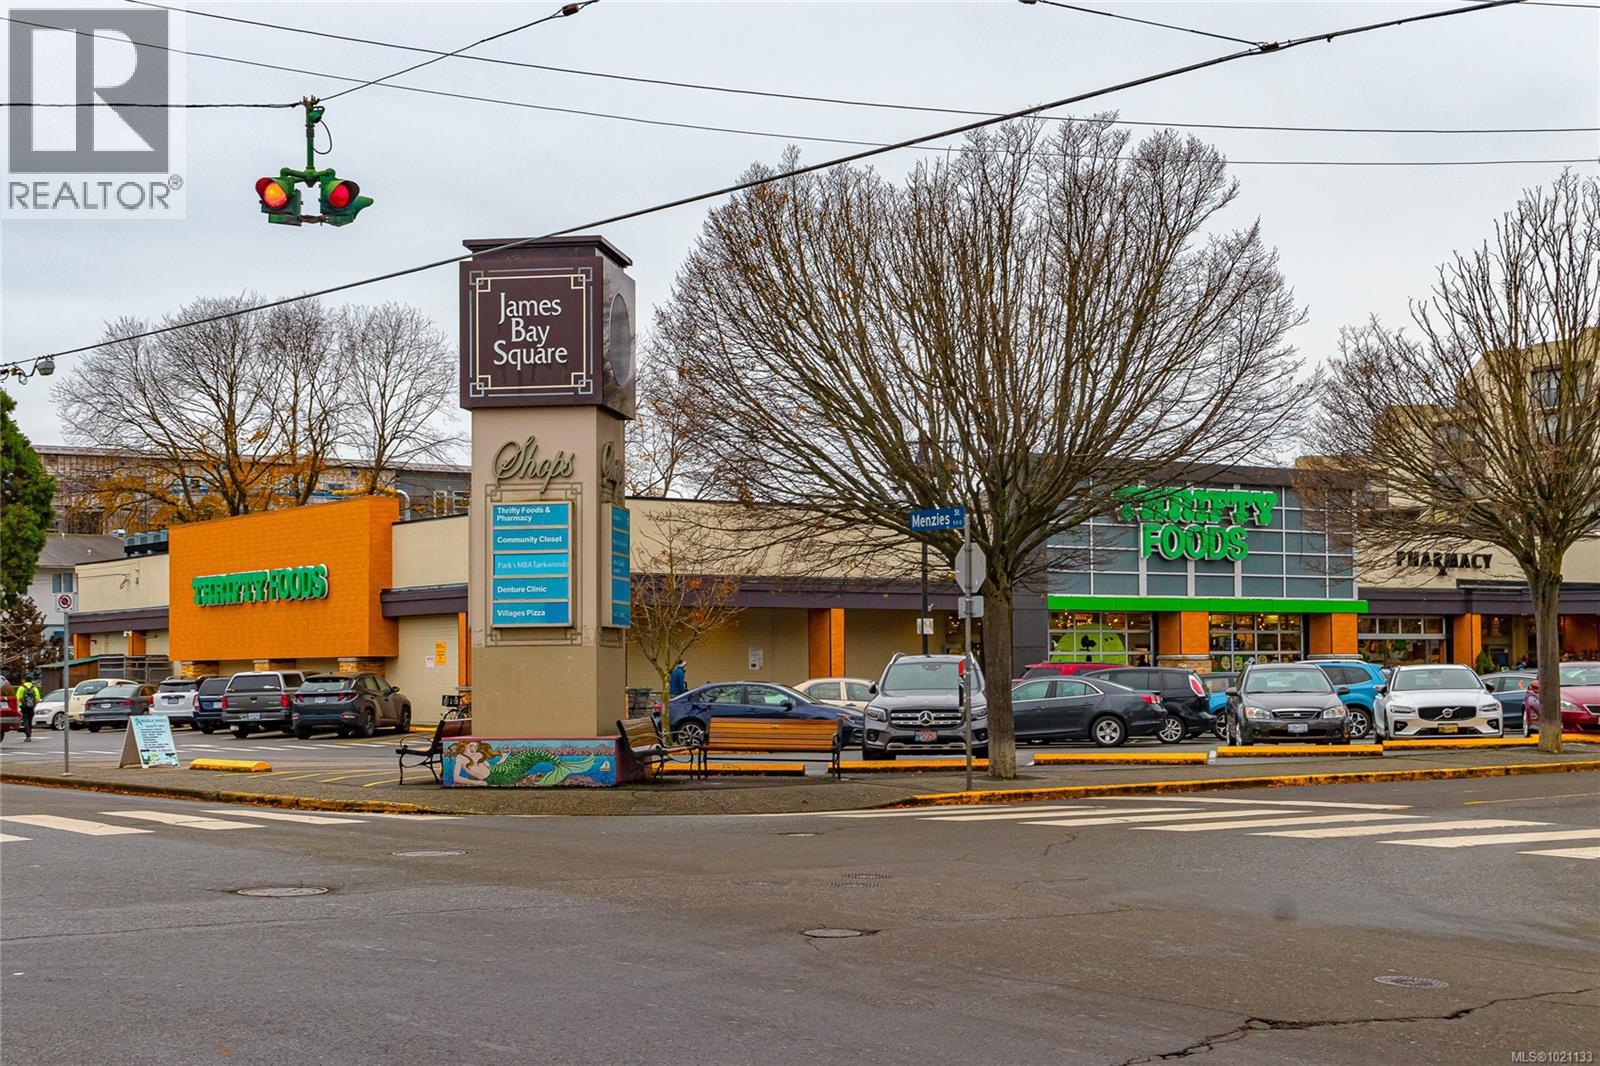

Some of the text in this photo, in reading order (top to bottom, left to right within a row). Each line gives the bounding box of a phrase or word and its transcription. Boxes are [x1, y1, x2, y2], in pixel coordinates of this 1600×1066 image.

[498, 292, 562, 325] James
[511, 318, 550, 348] Bay
[493, 340, 568, 371] Square
[493, 435, 576, 495] Shops
[497, 507, 520, 515] Thrifty
[912, 512, 951, 528] Menzies
[497, 536, 538, 544] Community
[1140, 522, 1249, 562] FOODS
[1396, 551, 1493, 572] PHARMACY
[191, 563, 329, 606] THRIFTY FOODS
[497, 610, 526, 618] Villages
